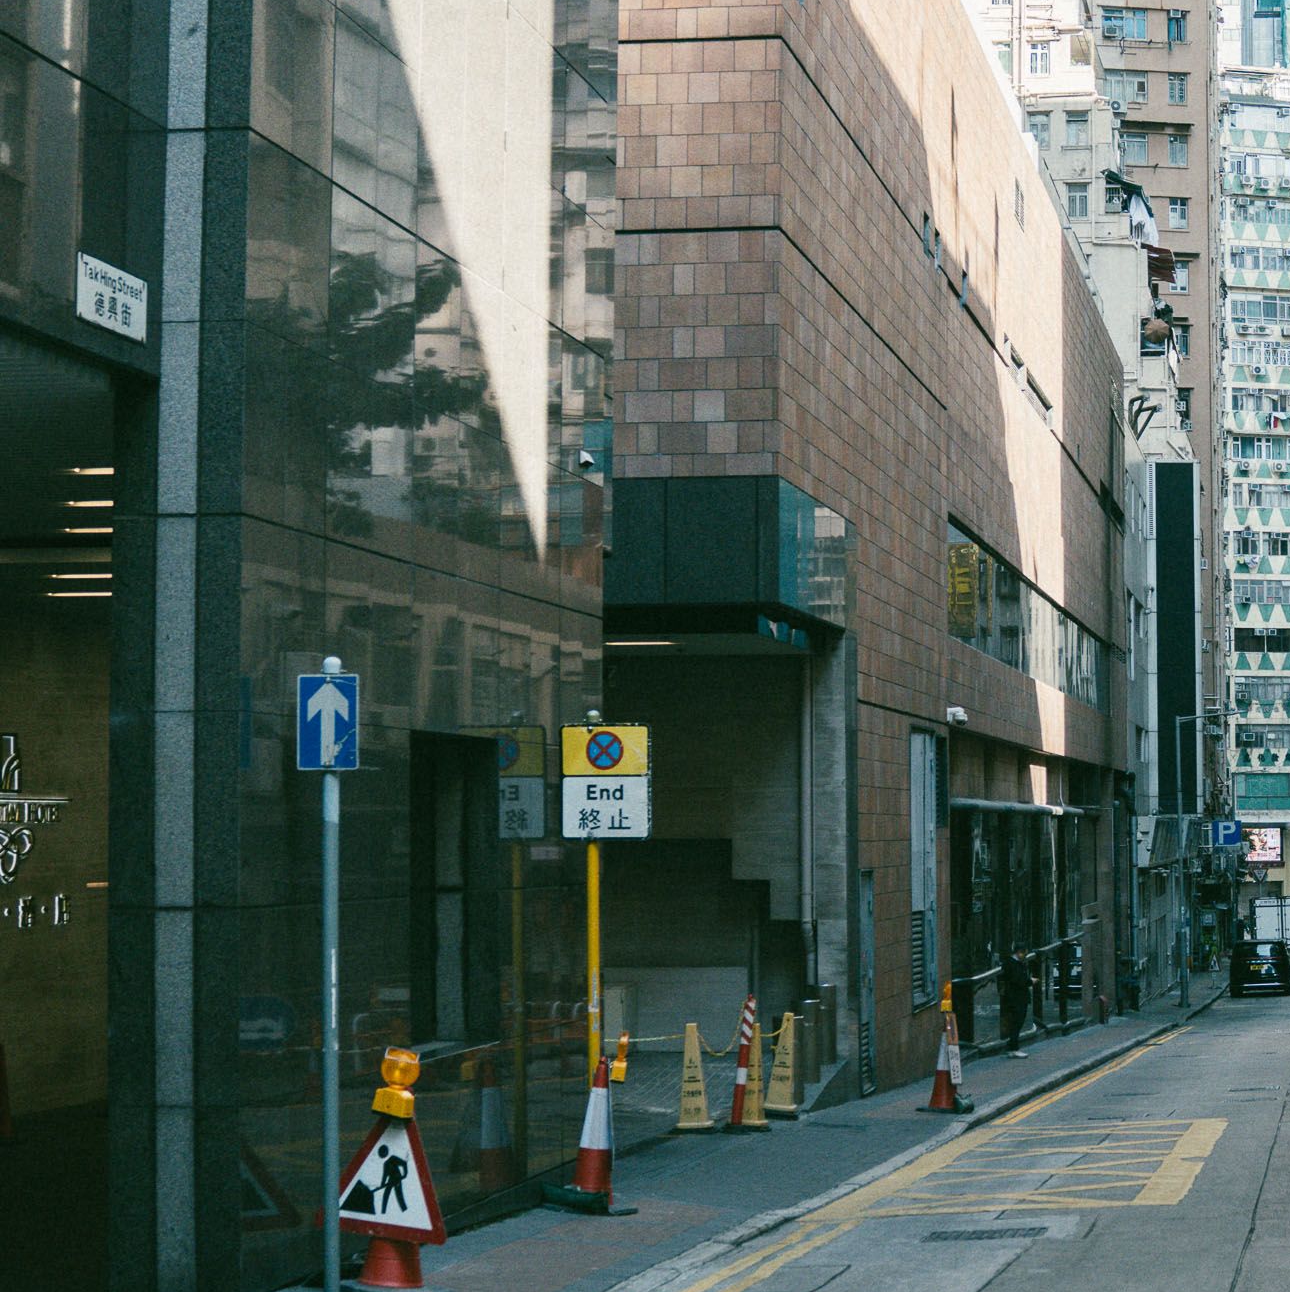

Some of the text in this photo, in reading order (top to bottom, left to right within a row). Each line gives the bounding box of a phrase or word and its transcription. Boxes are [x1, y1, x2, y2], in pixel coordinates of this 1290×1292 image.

[83, 261, 142, 302] Tak Hing Street
[586, 784, 624, 801] End
[578, 807, 632, 831] 終止
[1218, 821, 1237, 845] P
